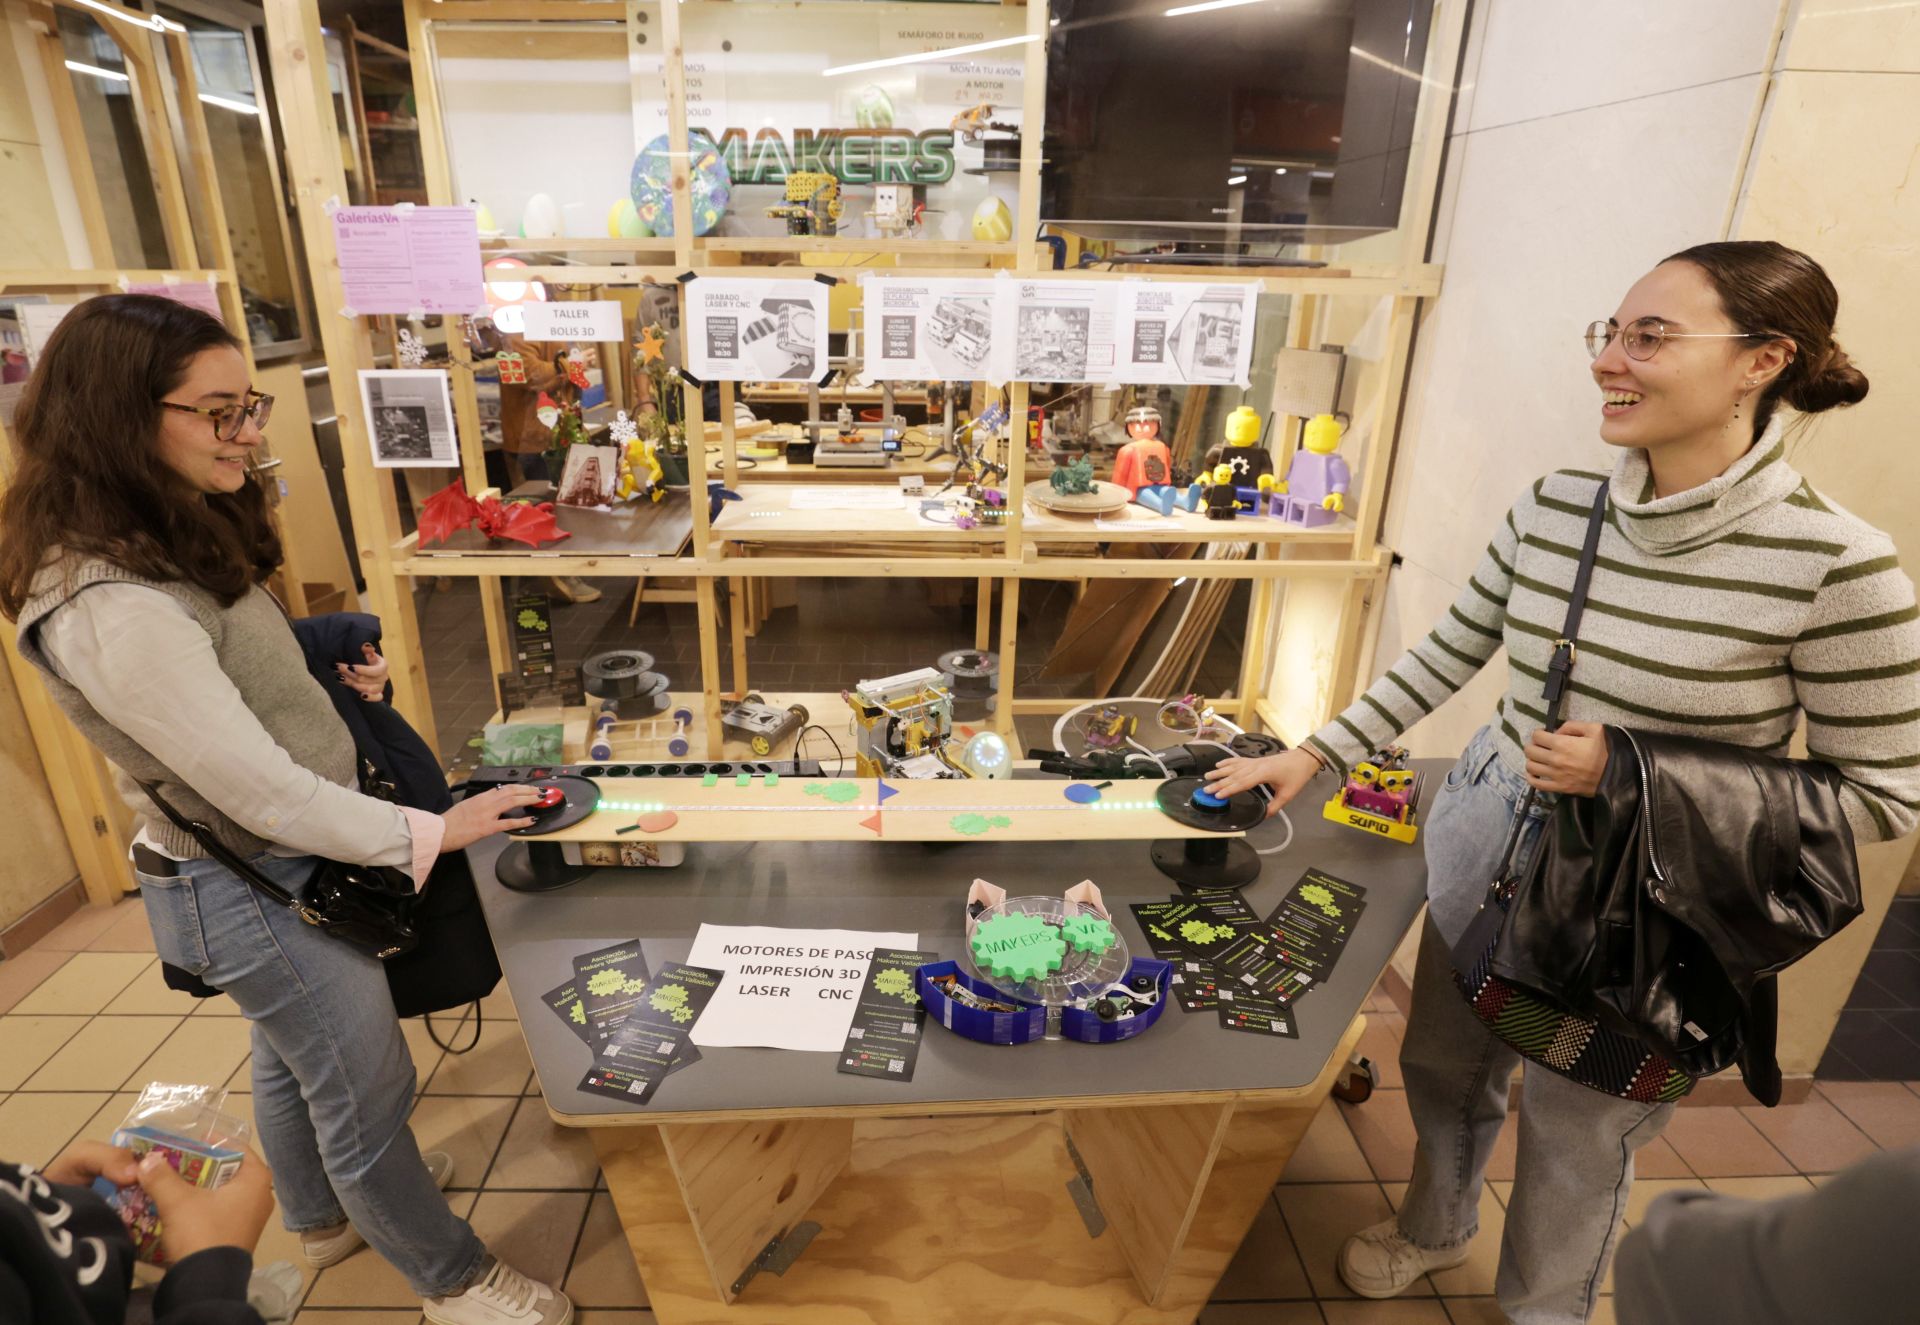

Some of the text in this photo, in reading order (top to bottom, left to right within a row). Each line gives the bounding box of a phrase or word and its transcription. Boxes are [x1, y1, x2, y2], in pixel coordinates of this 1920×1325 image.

[950, 65, 1021, 76] MONTA TU AVIÓN
[974, 81, 1004, 89] MOTOR
[553, 309, 590, 318] TALLER
[550, 327, 595, 336] BOLIS 3D
[1075, 923, 1103, 935] VA
[985, 930, 1052, 954] MAKERS
[722, 944, 804, 957] MOTORES
[808, 948, 830, 958] DE
[889, 952, 923, 961] Asociación
[739, 964, 861, 980] IMPRESIÓN 3D
[738, 984, 854, 1000] LASER CNC
